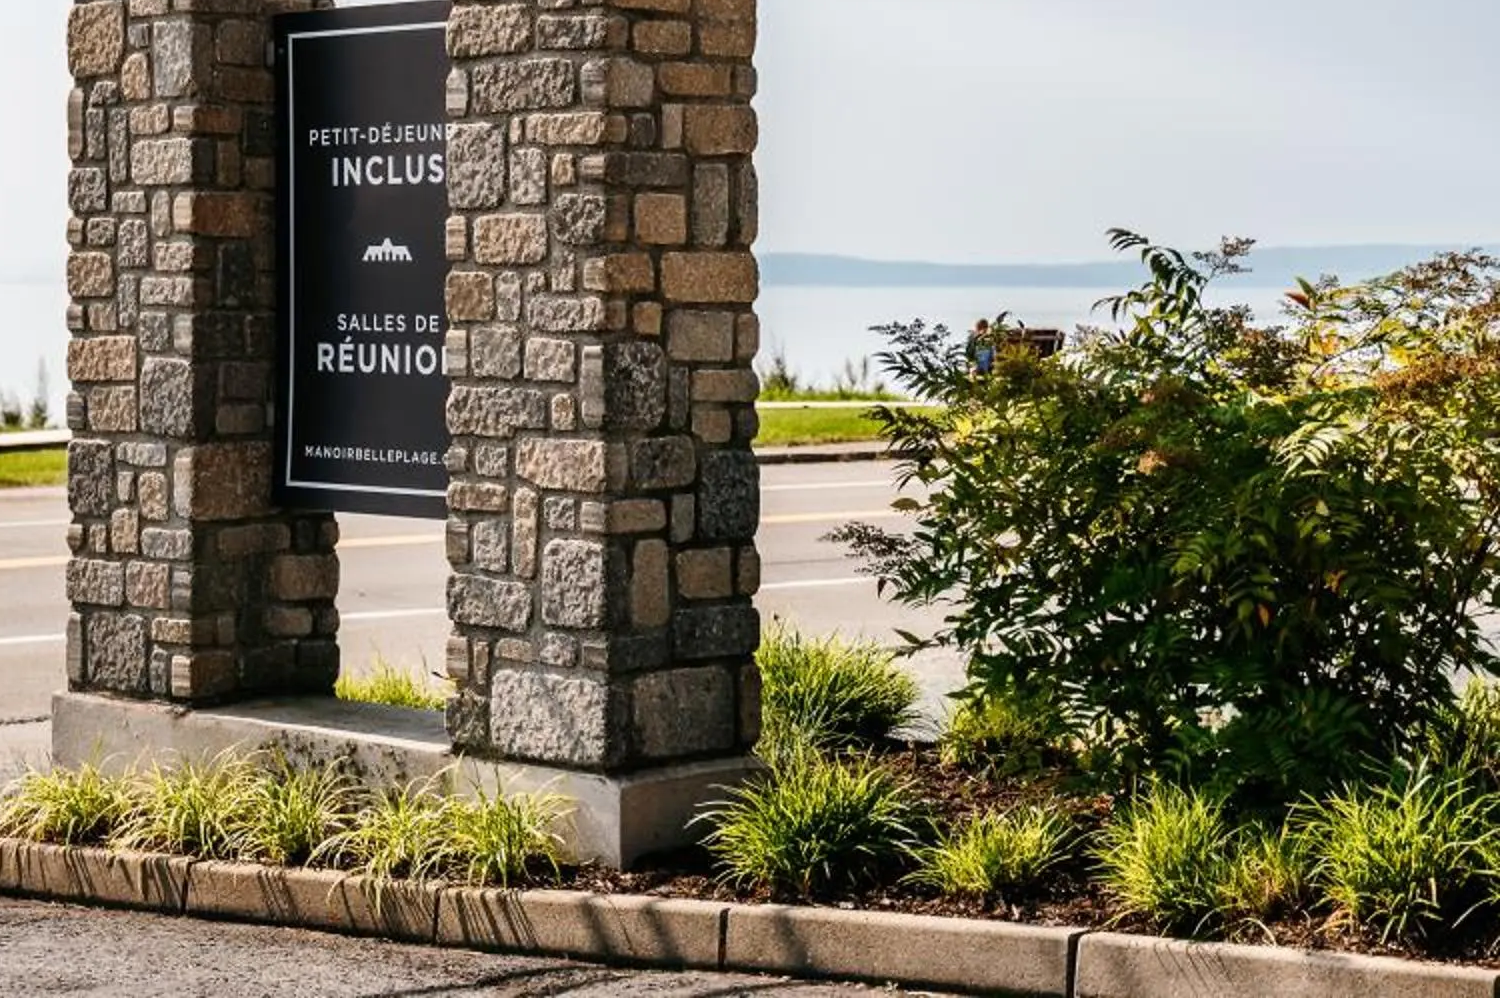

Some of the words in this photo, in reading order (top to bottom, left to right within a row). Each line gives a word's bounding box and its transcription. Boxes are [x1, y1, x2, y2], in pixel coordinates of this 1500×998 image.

[332, 154, 445, 186] INCLUS
[337, 313, 406, 332] SALLES
[415, 315, 440, 333] DE
